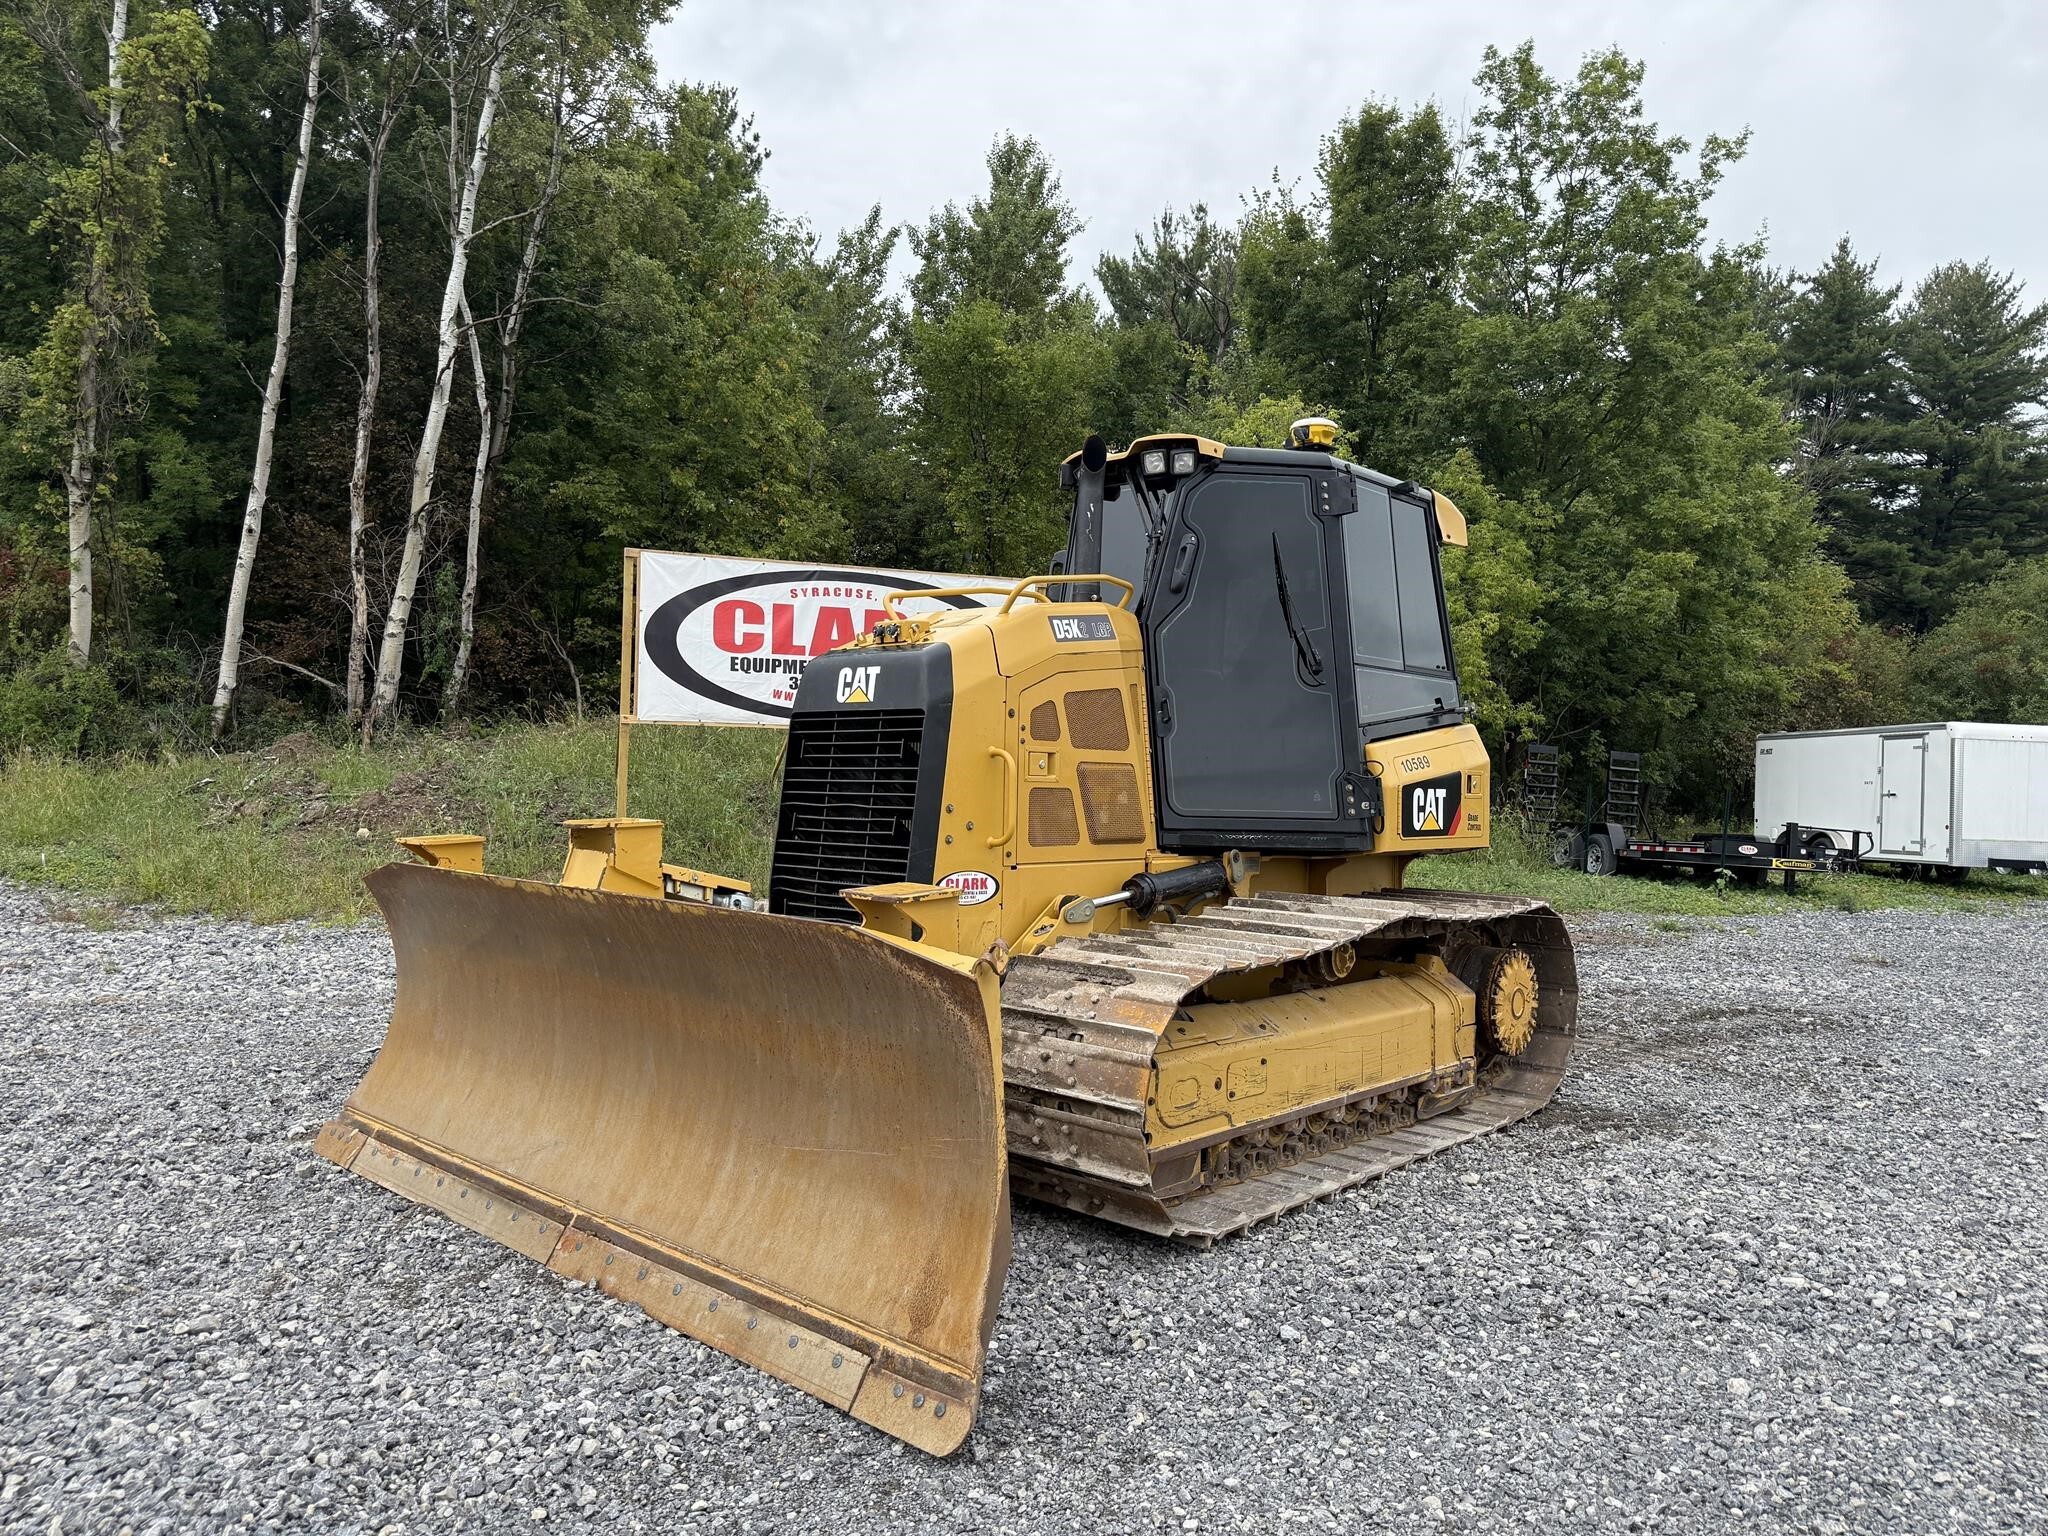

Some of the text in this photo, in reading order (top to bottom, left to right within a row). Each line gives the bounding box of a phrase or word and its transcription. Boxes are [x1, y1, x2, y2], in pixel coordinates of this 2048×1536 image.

[1091, 621, 1112, 638] LGP
[836, 665, 881, 704] CAT
[1400, 755, 1431, 774] 10589
[1412, 787, 1447, 831] CAT
[1772, 859, 1813, 869] Kaufman
[945, 877, 989, 891] CLARK
